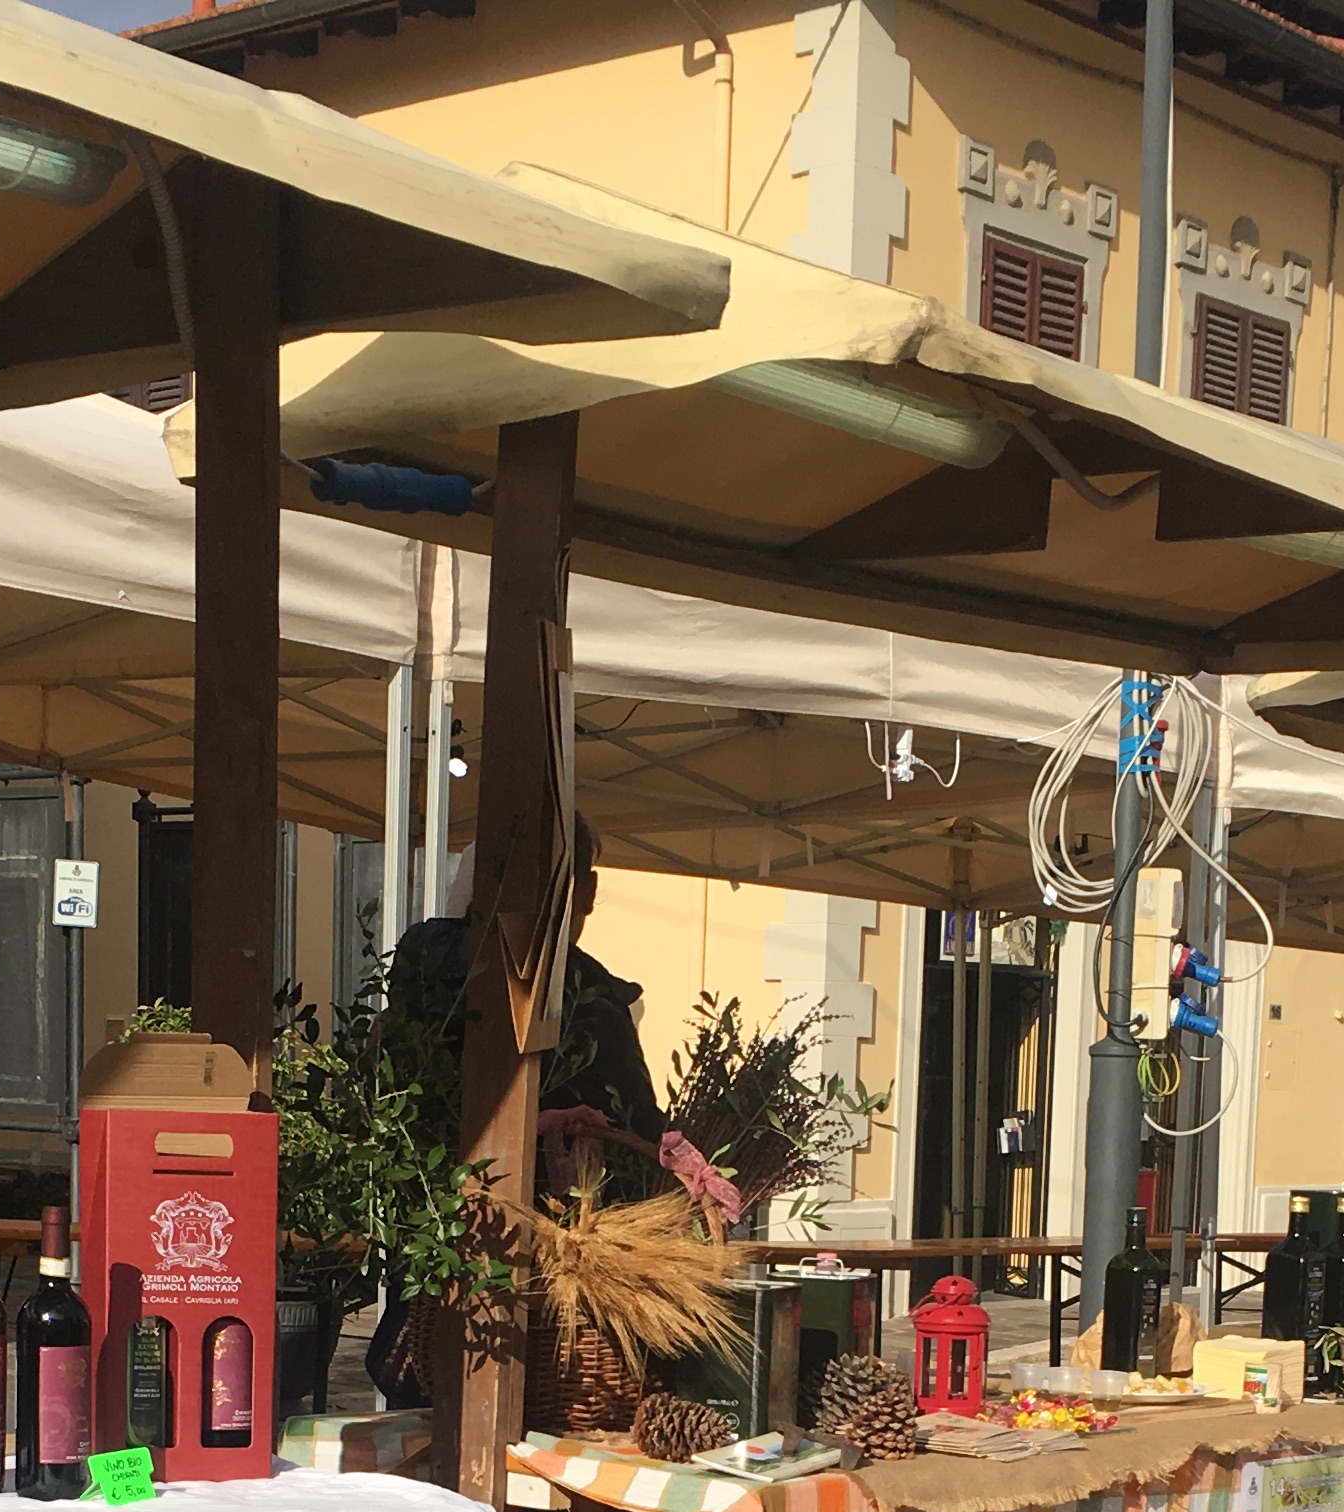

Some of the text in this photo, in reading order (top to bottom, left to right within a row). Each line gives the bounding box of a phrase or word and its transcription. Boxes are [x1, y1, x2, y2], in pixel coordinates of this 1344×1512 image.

[139, 1274, 242, 1284] AZIENDA AGRICOLA
[142, 1282, 239, 1292] GRIMOLI MONTAIO
[149, 1296, 179, 1304] CASALE
[102, 1456, 143, 1472] VINO BIO
